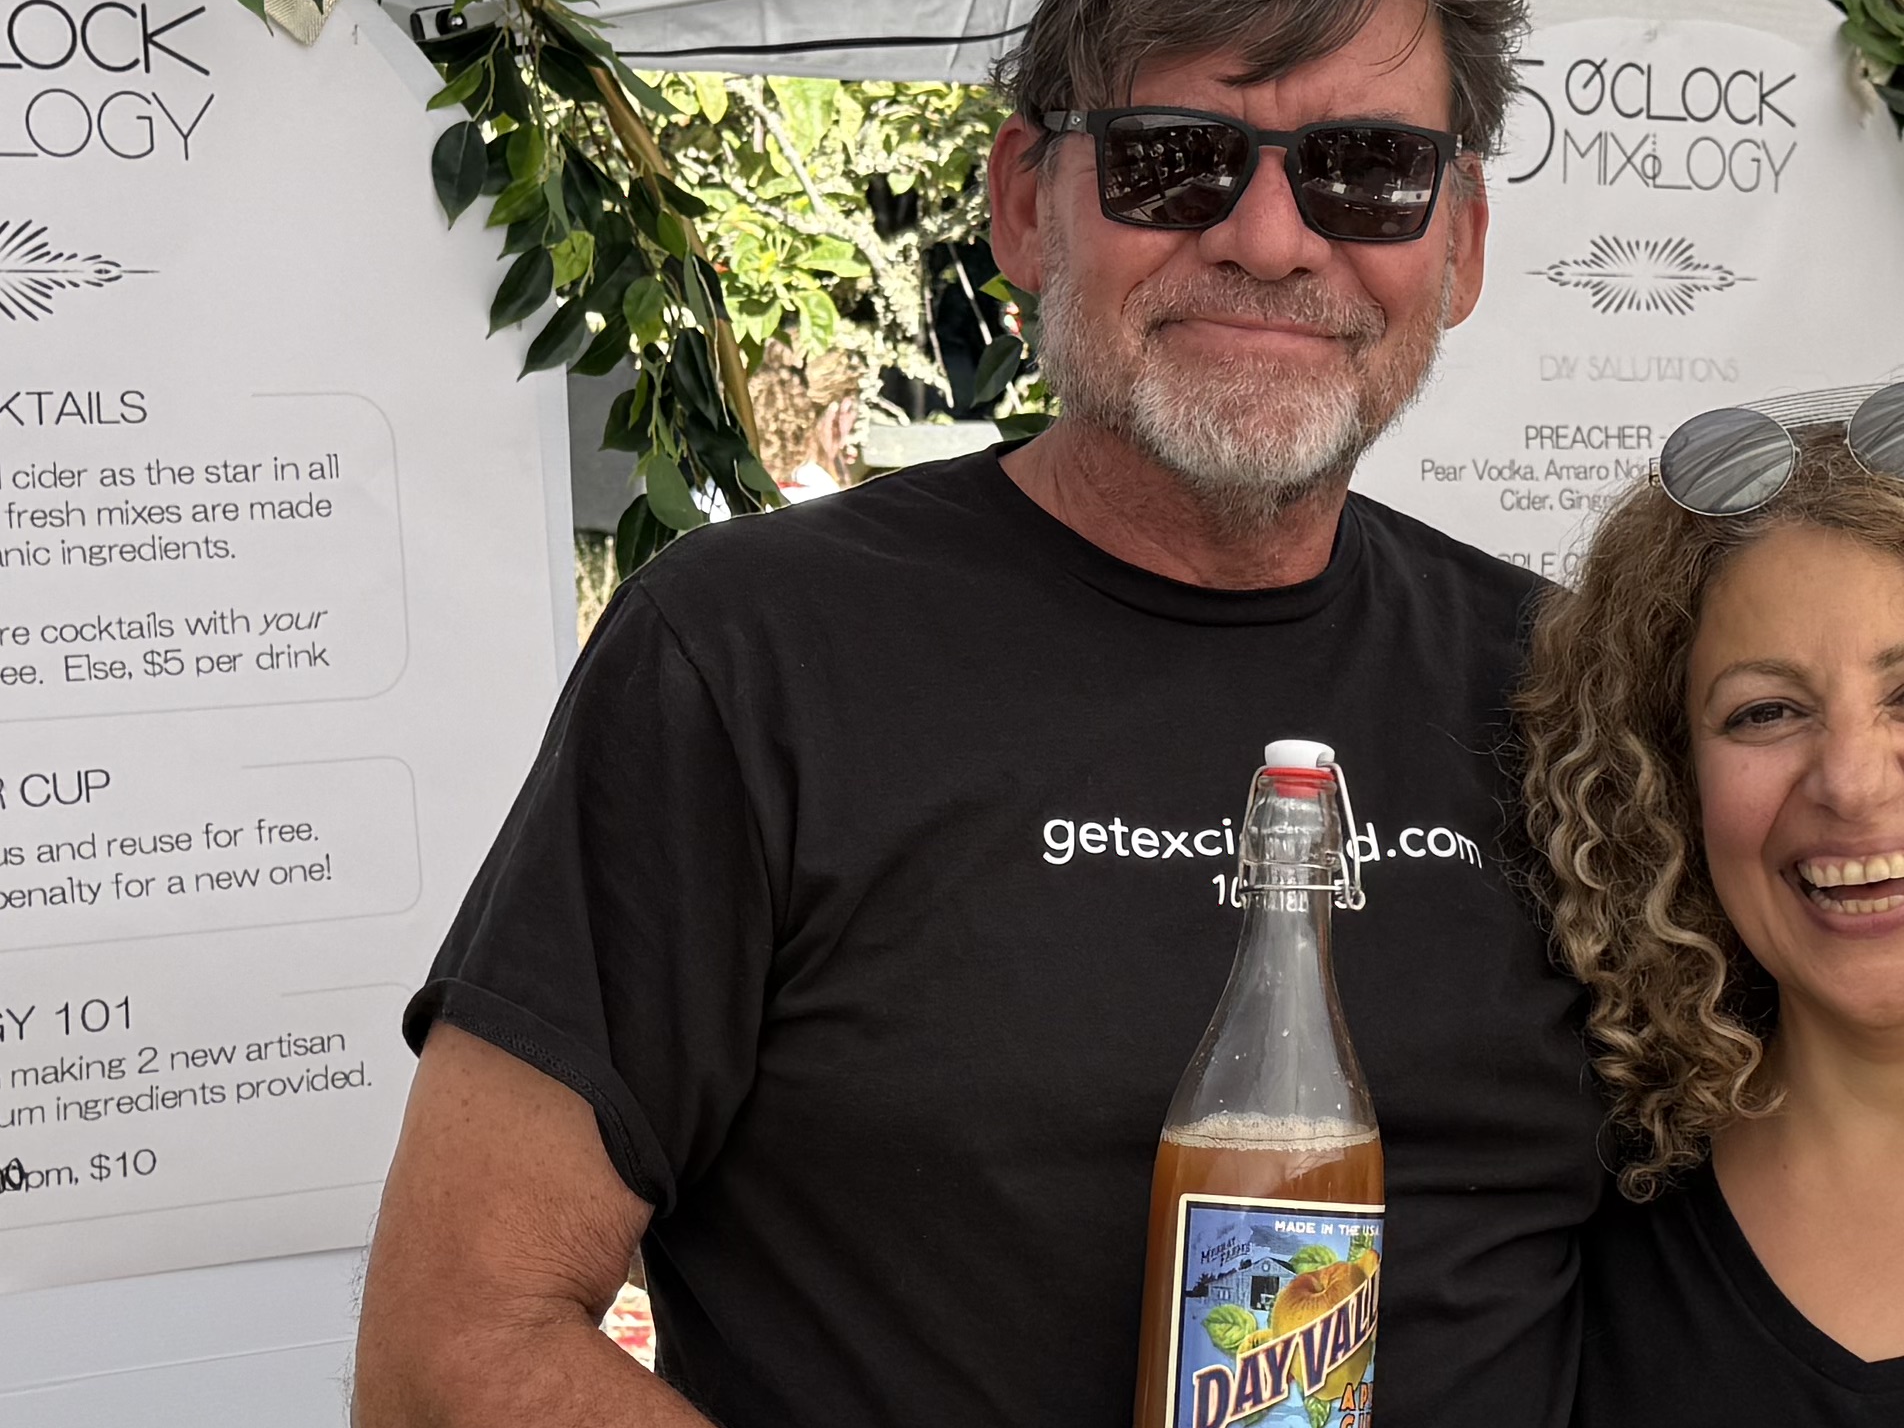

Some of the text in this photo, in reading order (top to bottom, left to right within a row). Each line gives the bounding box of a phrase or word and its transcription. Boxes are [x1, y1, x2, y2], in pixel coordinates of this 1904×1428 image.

[1563, 128, 1798, 194] MIXOLOGY
[1525, 425, 1652, 450] PREACHER
[12, 461, 88, 489] cider
[100, 468, 135, 487] as
[144, 458, 194, 485] the
[205, 460, 262, 483] star
[274, 456, 300, 481] in
[308, 453, 339, 480] all
[1421, 459, 1467, 482] Pear
[1545, 459, 1610, 482] Amaro
[5, 500, 85, 529] fresh
[97, 499, 183, 526] mixes
[191, 503, 239, 522] are
[250, 492, 332, 520] made
[61, 534, 235, 566] ingredients.
[41, 612, 174, 644] cocktails
[185, 608, 251, 636] with
[258, 610, 328, 636] your
[64, 654, 132, 682] Else,
[143, 649, 184, 678] $5
[196, 653, 243, 677] per
[256, 641, 330, 670] drink
[20, 769, 110, 807] CUP
[37, 832, 96, 863] and
[107, 833, 192, 857] reuse
[202, 823, 244, 849] for
[255, 819, 318, 844] free.
[110, 872, 156, 900] for
[167, 876, 187, 894] a
[194, 868, 261, 892] new
[268, 853, 331, 885] one!
[55, 996, 129, 1035] 101
[11, 1055, 126, 1088] making
[138, 1047, 159, 1074] 2
[171, 1045, 237, 1071] new
[245, 1033, 345, 1071] artisan
[56, 1083, 226, 1121] ingredients
[236, 1061, 372, 1104] provided.
[90, 1149, 157, 1182] $10
[1275, 1220, 1316, 1234] MADE
[1321, 1223, 1333, 1235] IN
[1338, 1224, 1360, 1236] THE
